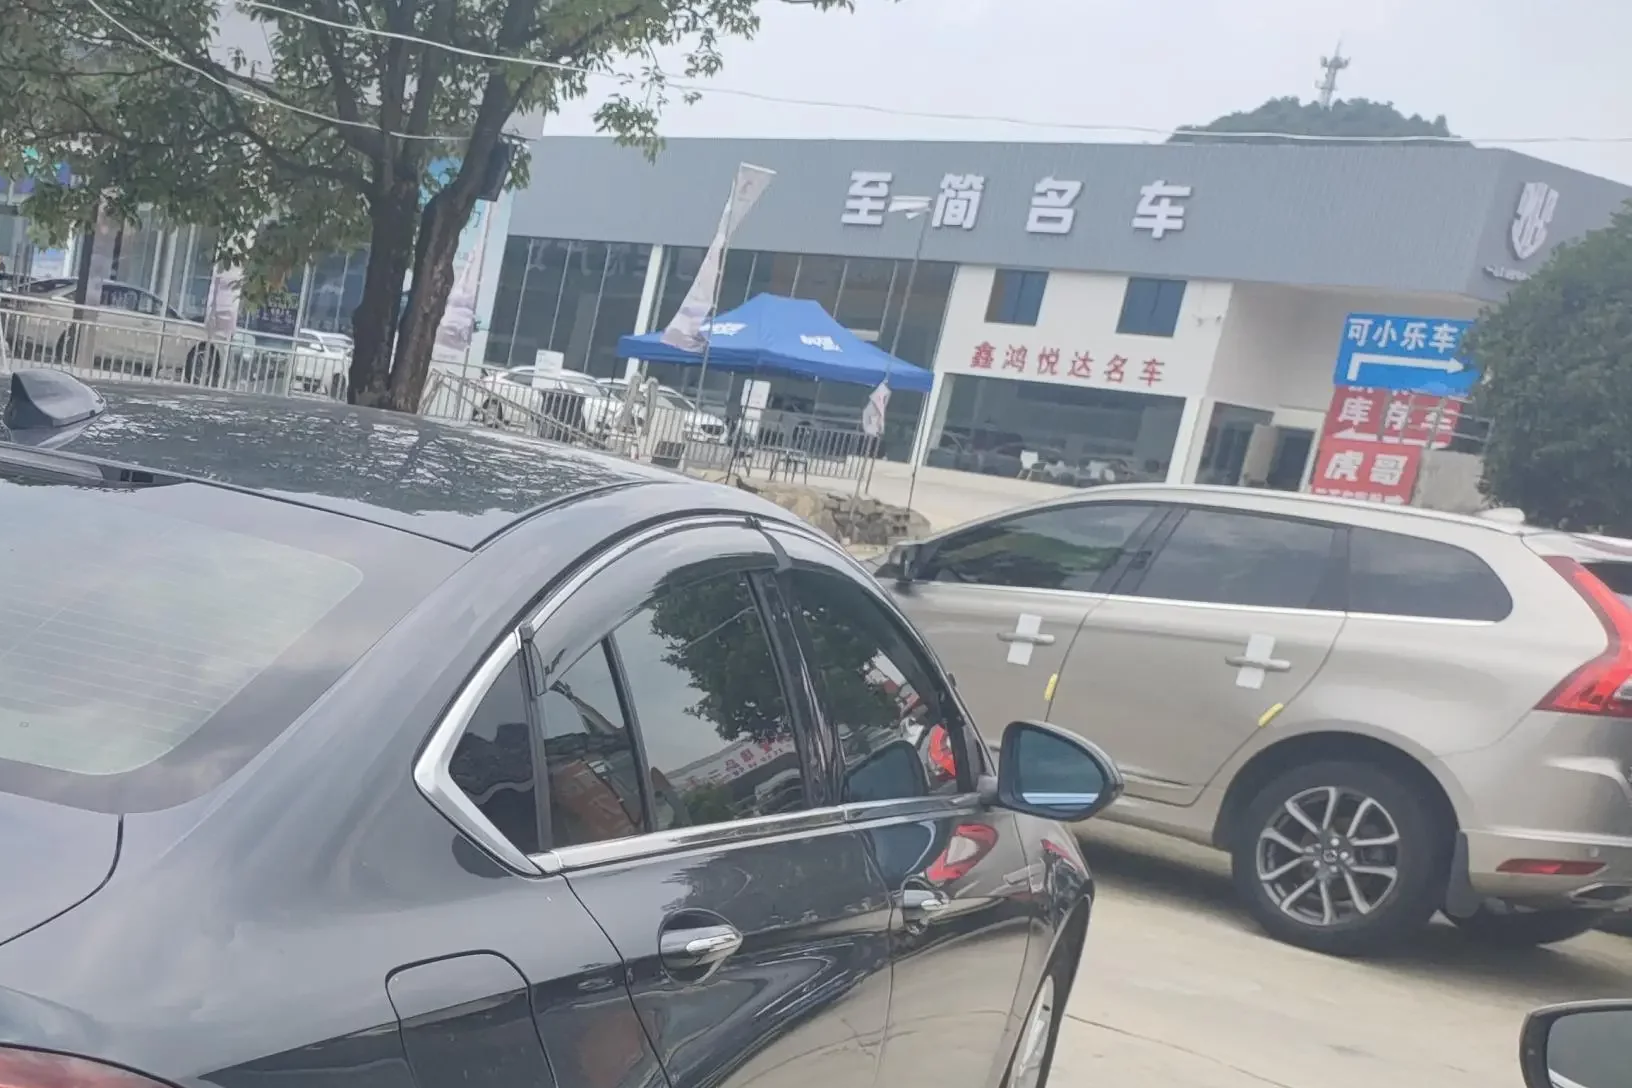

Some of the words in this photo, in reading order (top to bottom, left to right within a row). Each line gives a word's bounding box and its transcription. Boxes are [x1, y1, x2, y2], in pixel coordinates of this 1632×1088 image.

[840, 170, 1192, 239] 至简名车
[1347, 318, 1465, 353] 可小乐车
[969, 341, 1166, 387] 鑫鸿悦达名车
[1324, 450, 1409, 486] 虎哥
